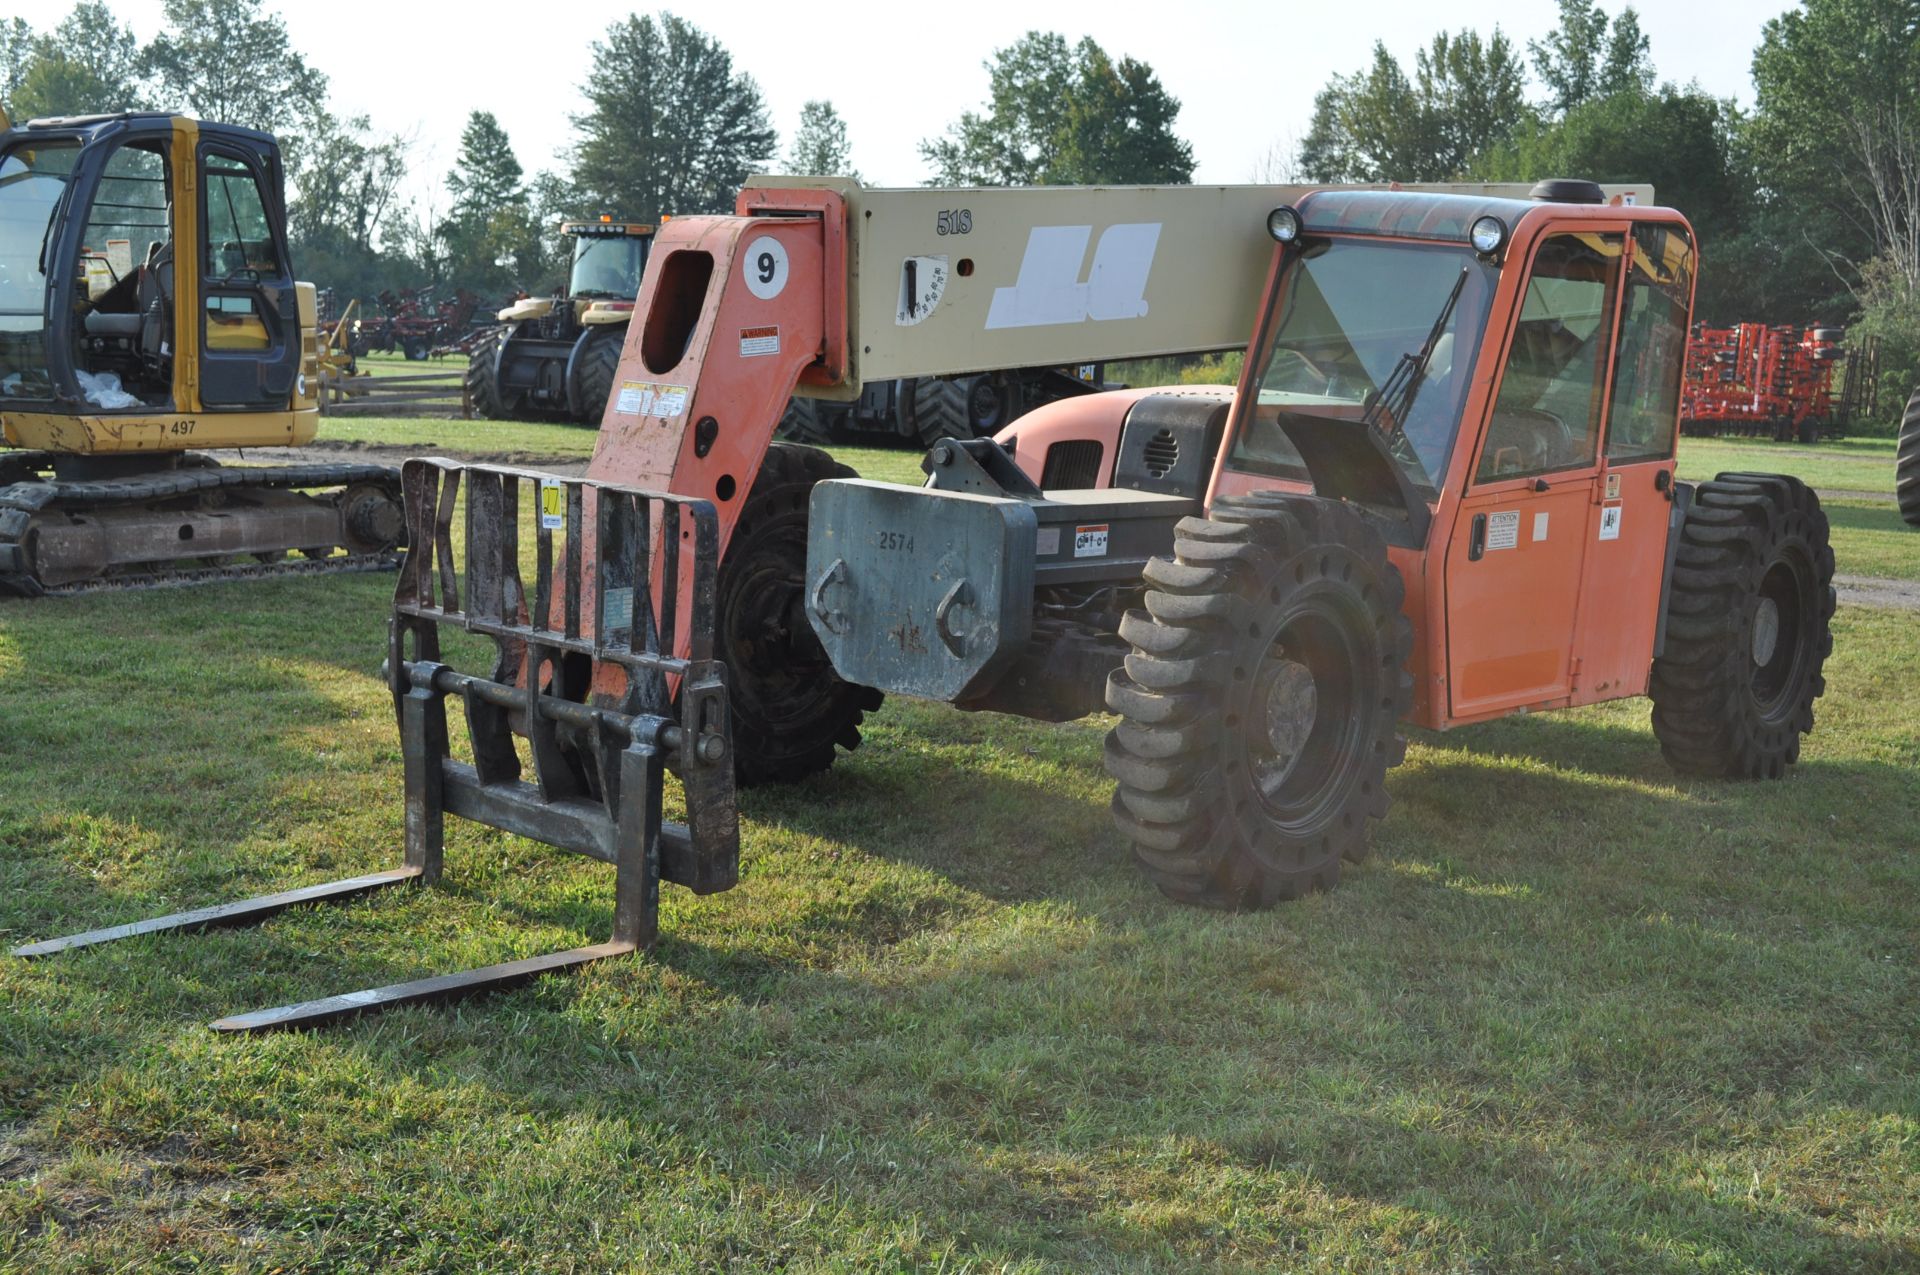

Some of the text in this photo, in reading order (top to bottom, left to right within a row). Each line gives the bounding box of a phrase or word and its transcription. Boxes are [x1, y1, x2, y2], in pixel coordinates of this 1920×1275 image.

[937, 209, 973, 236] 518
[757, 252, 775, 284] 9
[1079, 365, 1096, 380] CAT
[171, 420, 196, 435] 497
[542, 487, 559, 515] 27
[1491, 513, 1517, 523] ATTENTION
[880, 531, 914, 554] 2574
